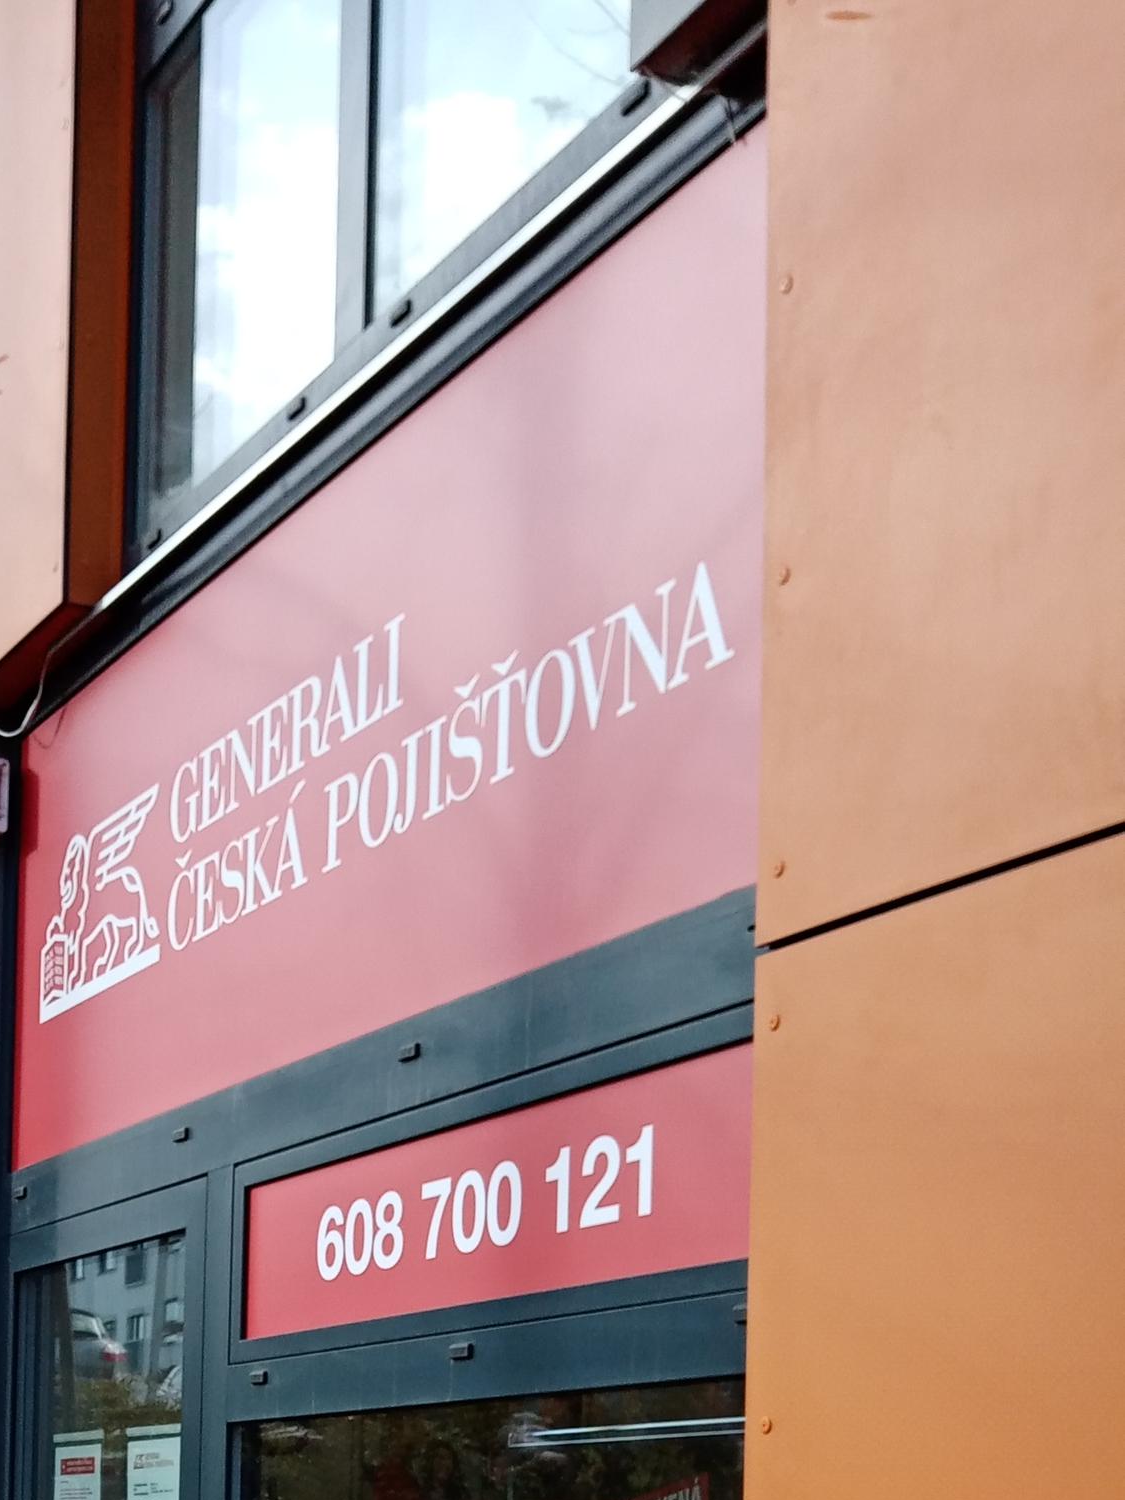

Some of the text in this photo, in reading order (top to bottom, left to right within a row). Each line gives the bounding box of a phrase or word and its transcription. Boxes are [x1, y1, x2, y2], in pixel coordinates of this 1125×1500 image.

[167, 561, 735, 952] ČESKÁ POJIŠŤOVNA
[169, 613, 405, 843] GENERALI
[316, 1124, 654, 1282] 608 700 121
